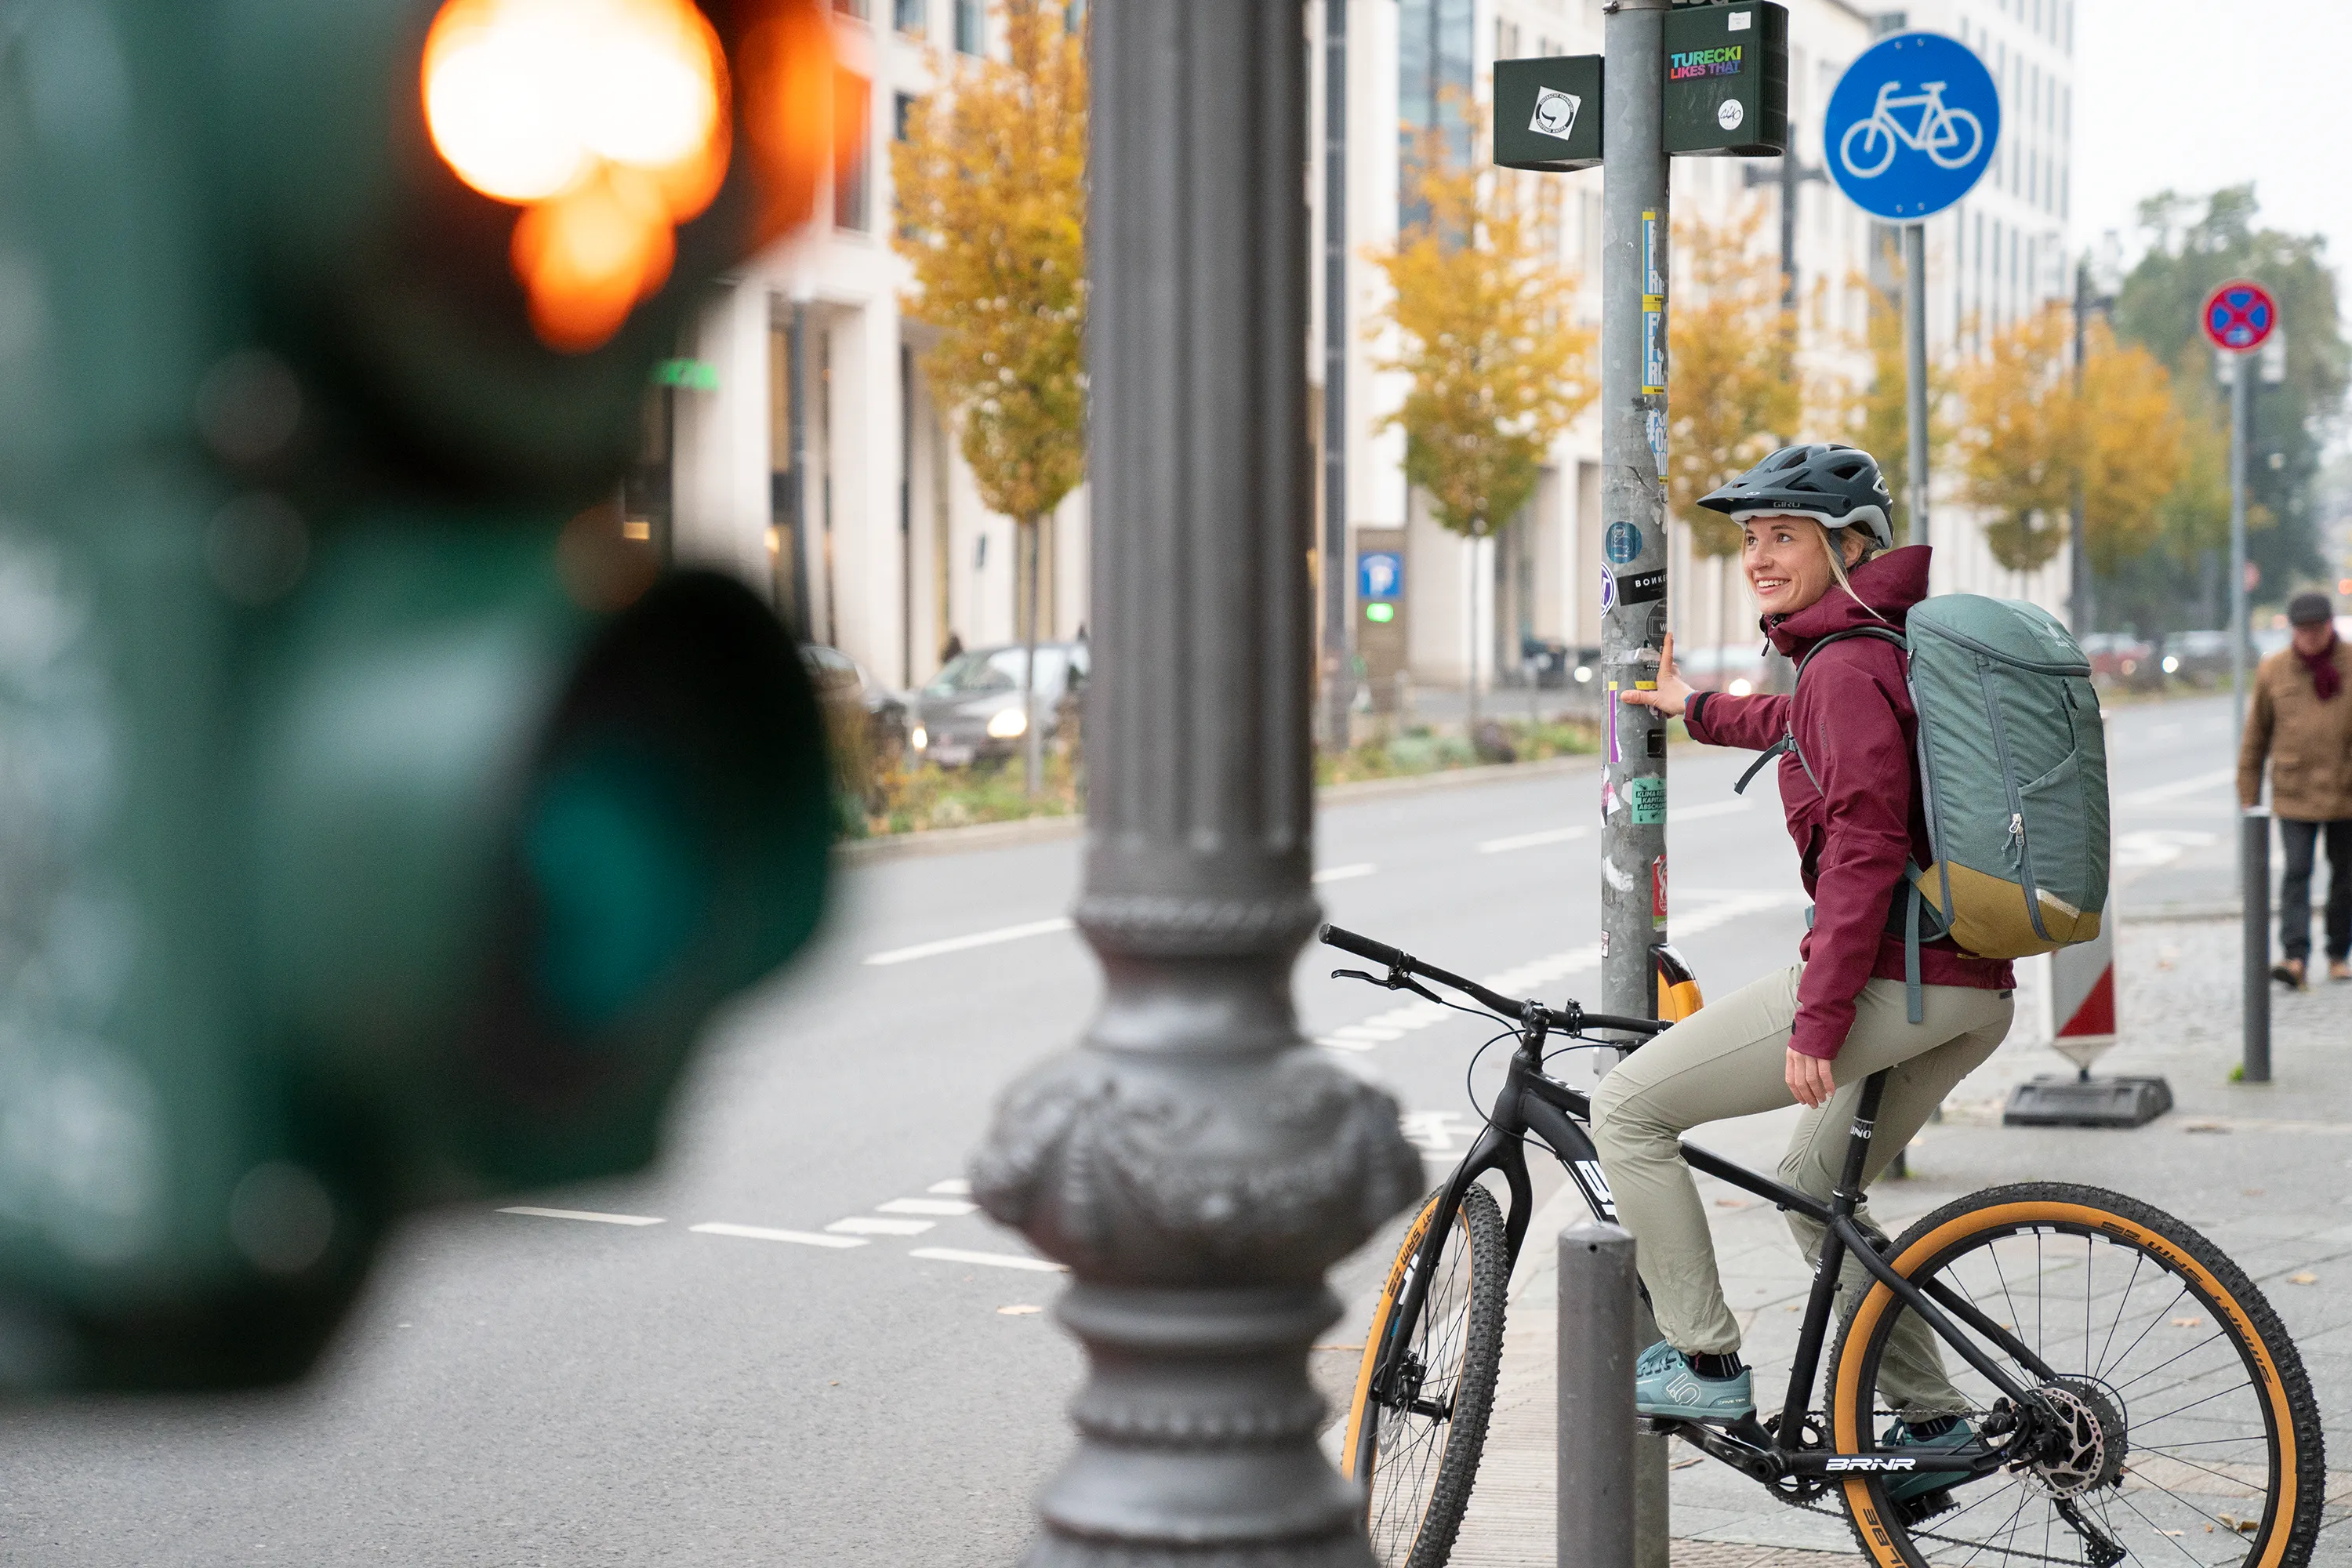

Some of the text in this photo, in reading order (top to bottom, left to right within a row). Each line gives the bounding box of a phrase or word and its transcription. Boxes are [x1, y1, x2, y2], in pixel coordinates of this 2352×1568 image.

[1671, 45, 1741, 68] TURECKI
[1671, 64, 1706, 79] LIKES
[1708, 60, 1740, 74] THAT
[1850, 1124, 1871, 1139] UNO
[1825, 1458, 1917, 1471] BRNR
